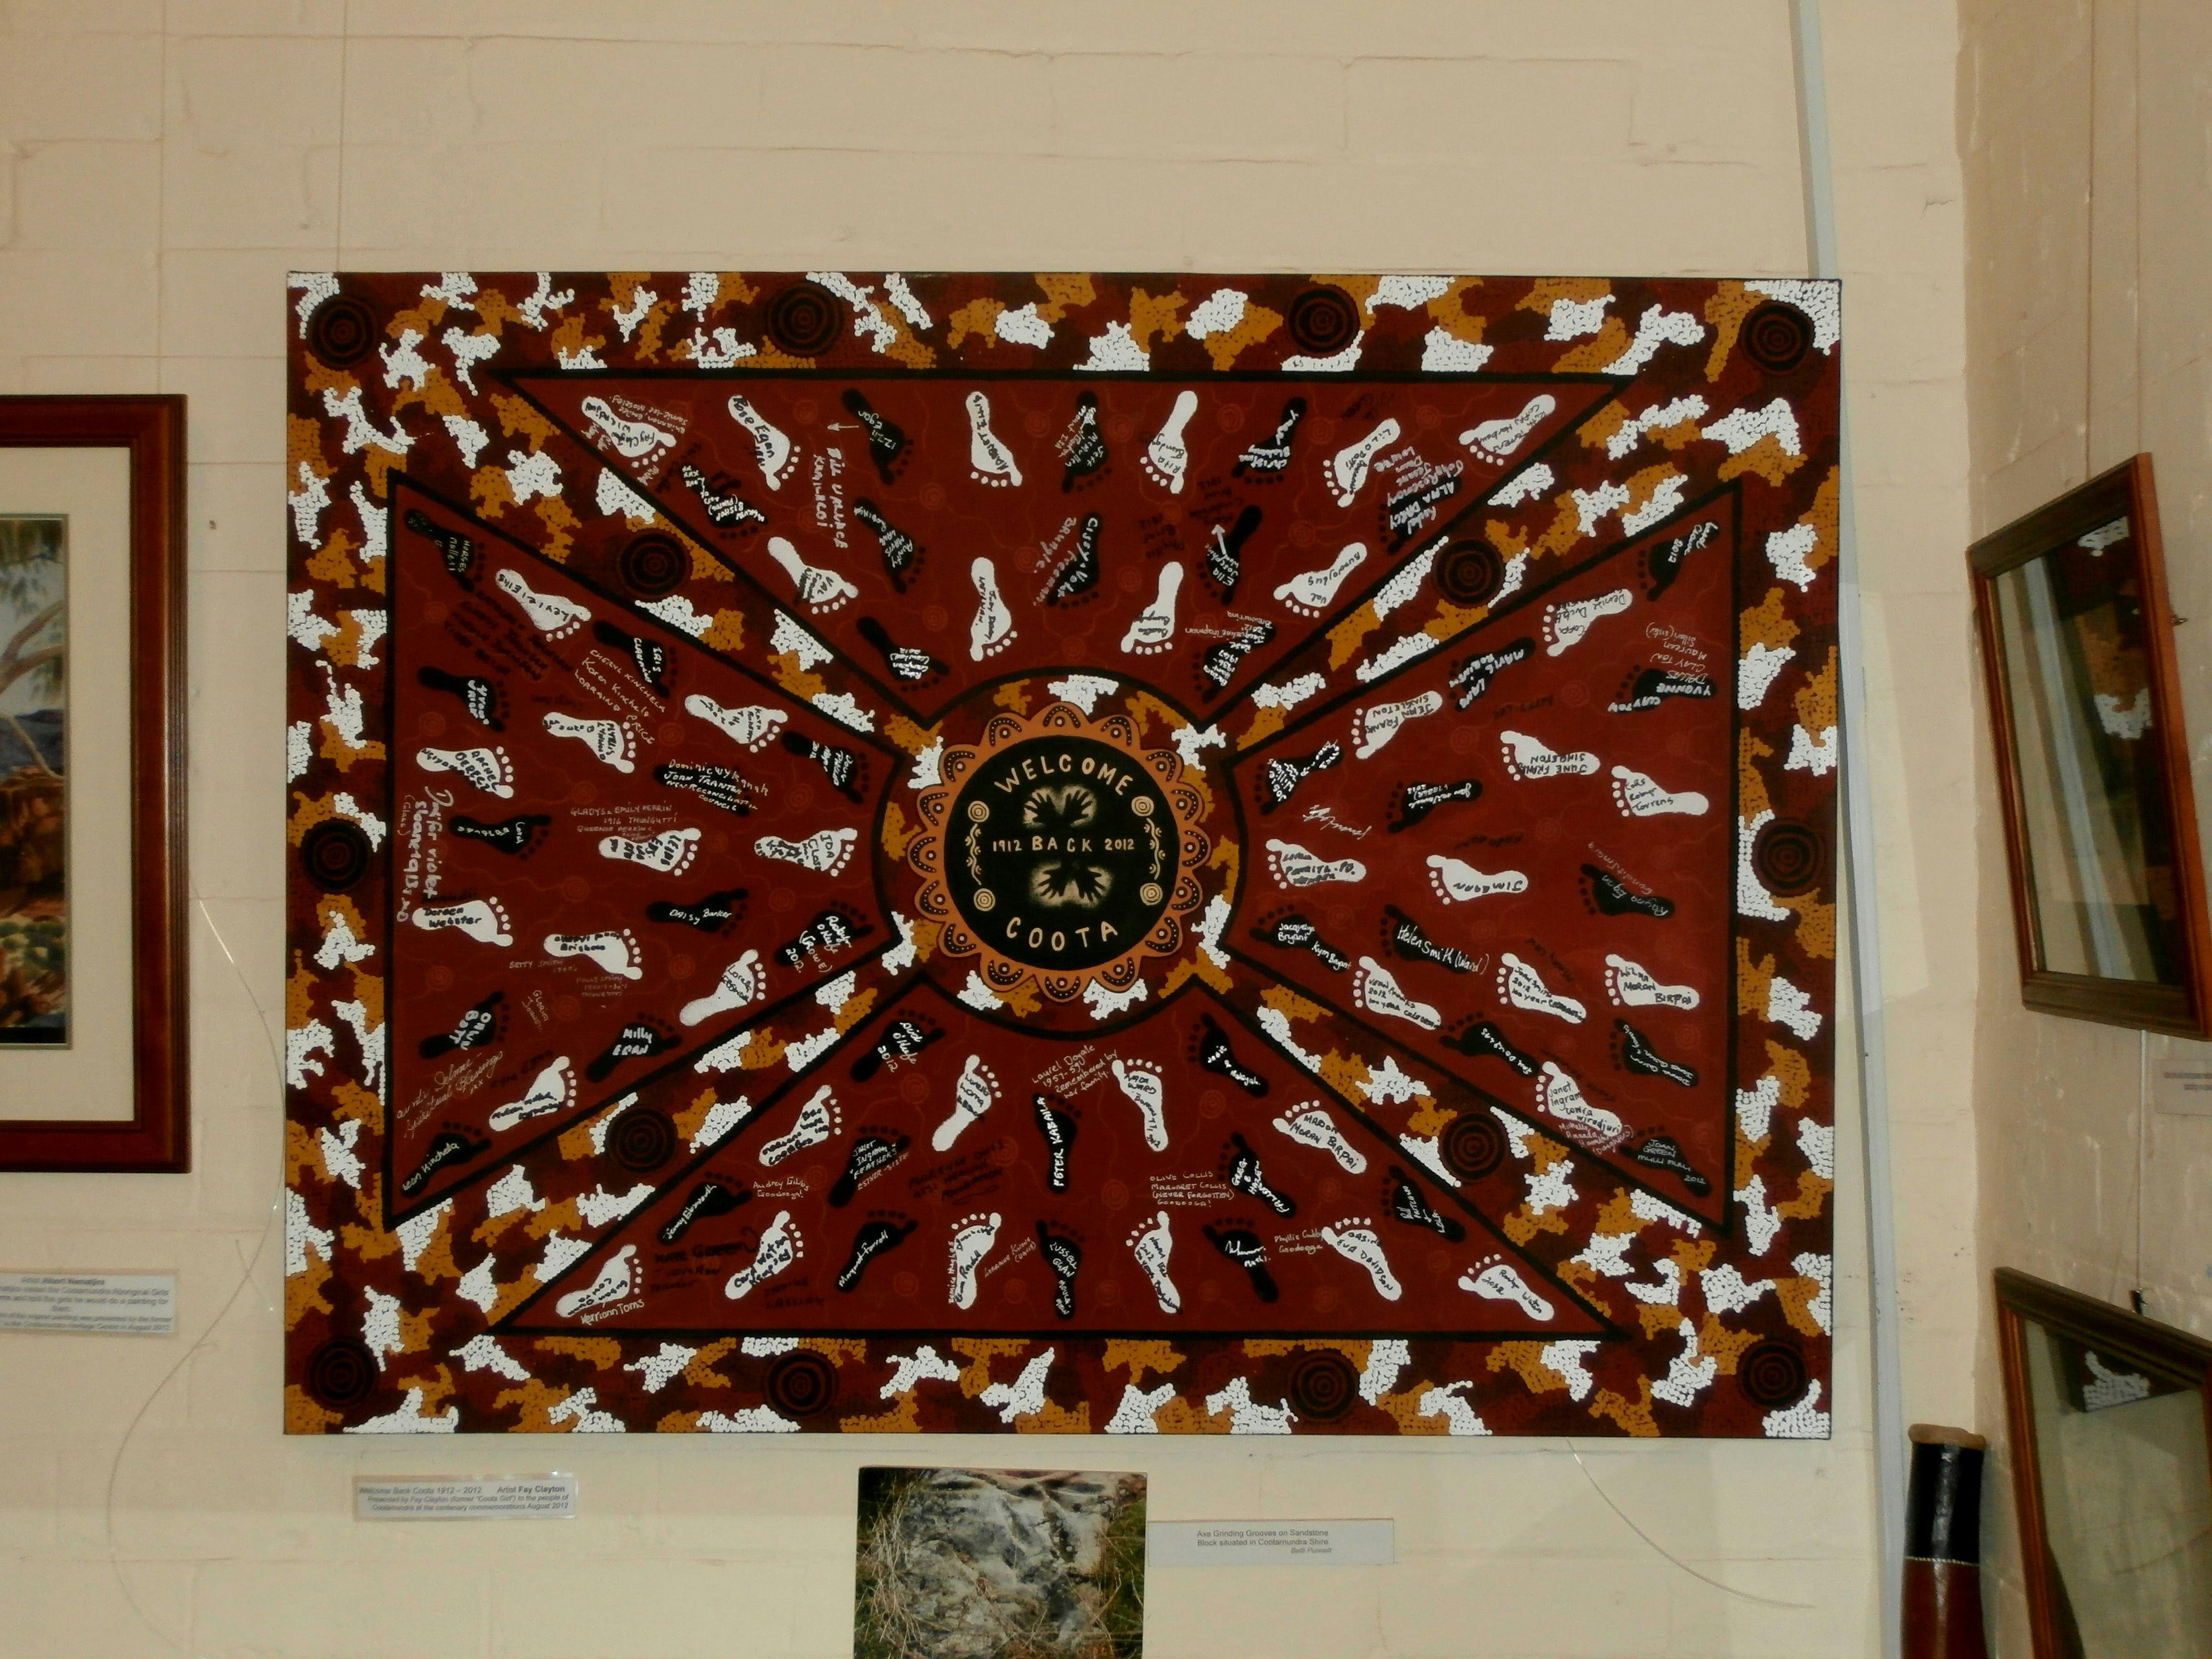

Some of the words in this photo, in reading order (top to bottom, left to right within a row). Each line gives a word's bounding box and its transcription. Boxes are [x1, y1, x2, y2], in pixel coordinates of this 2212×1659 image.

[994, 754, 1133, 796] WELCOME
[993, 839, 1022, 852] 1912
[1032, 835, 1092, 853] BACK
[1105, 838, 1135, 851] 2012
[1006, 916, 1118, 951] COOTA
[1396, 925, 1422, 948] Helen
[1054, 1058, 1106, 1094] Remembered
[1104, 1049, 1118, 1065] by
[786, 1177, 810, 1192] Gibbs
[618, 1299, 645, 1313] Toms
[535, 1485, 565, 1493] Clayton
